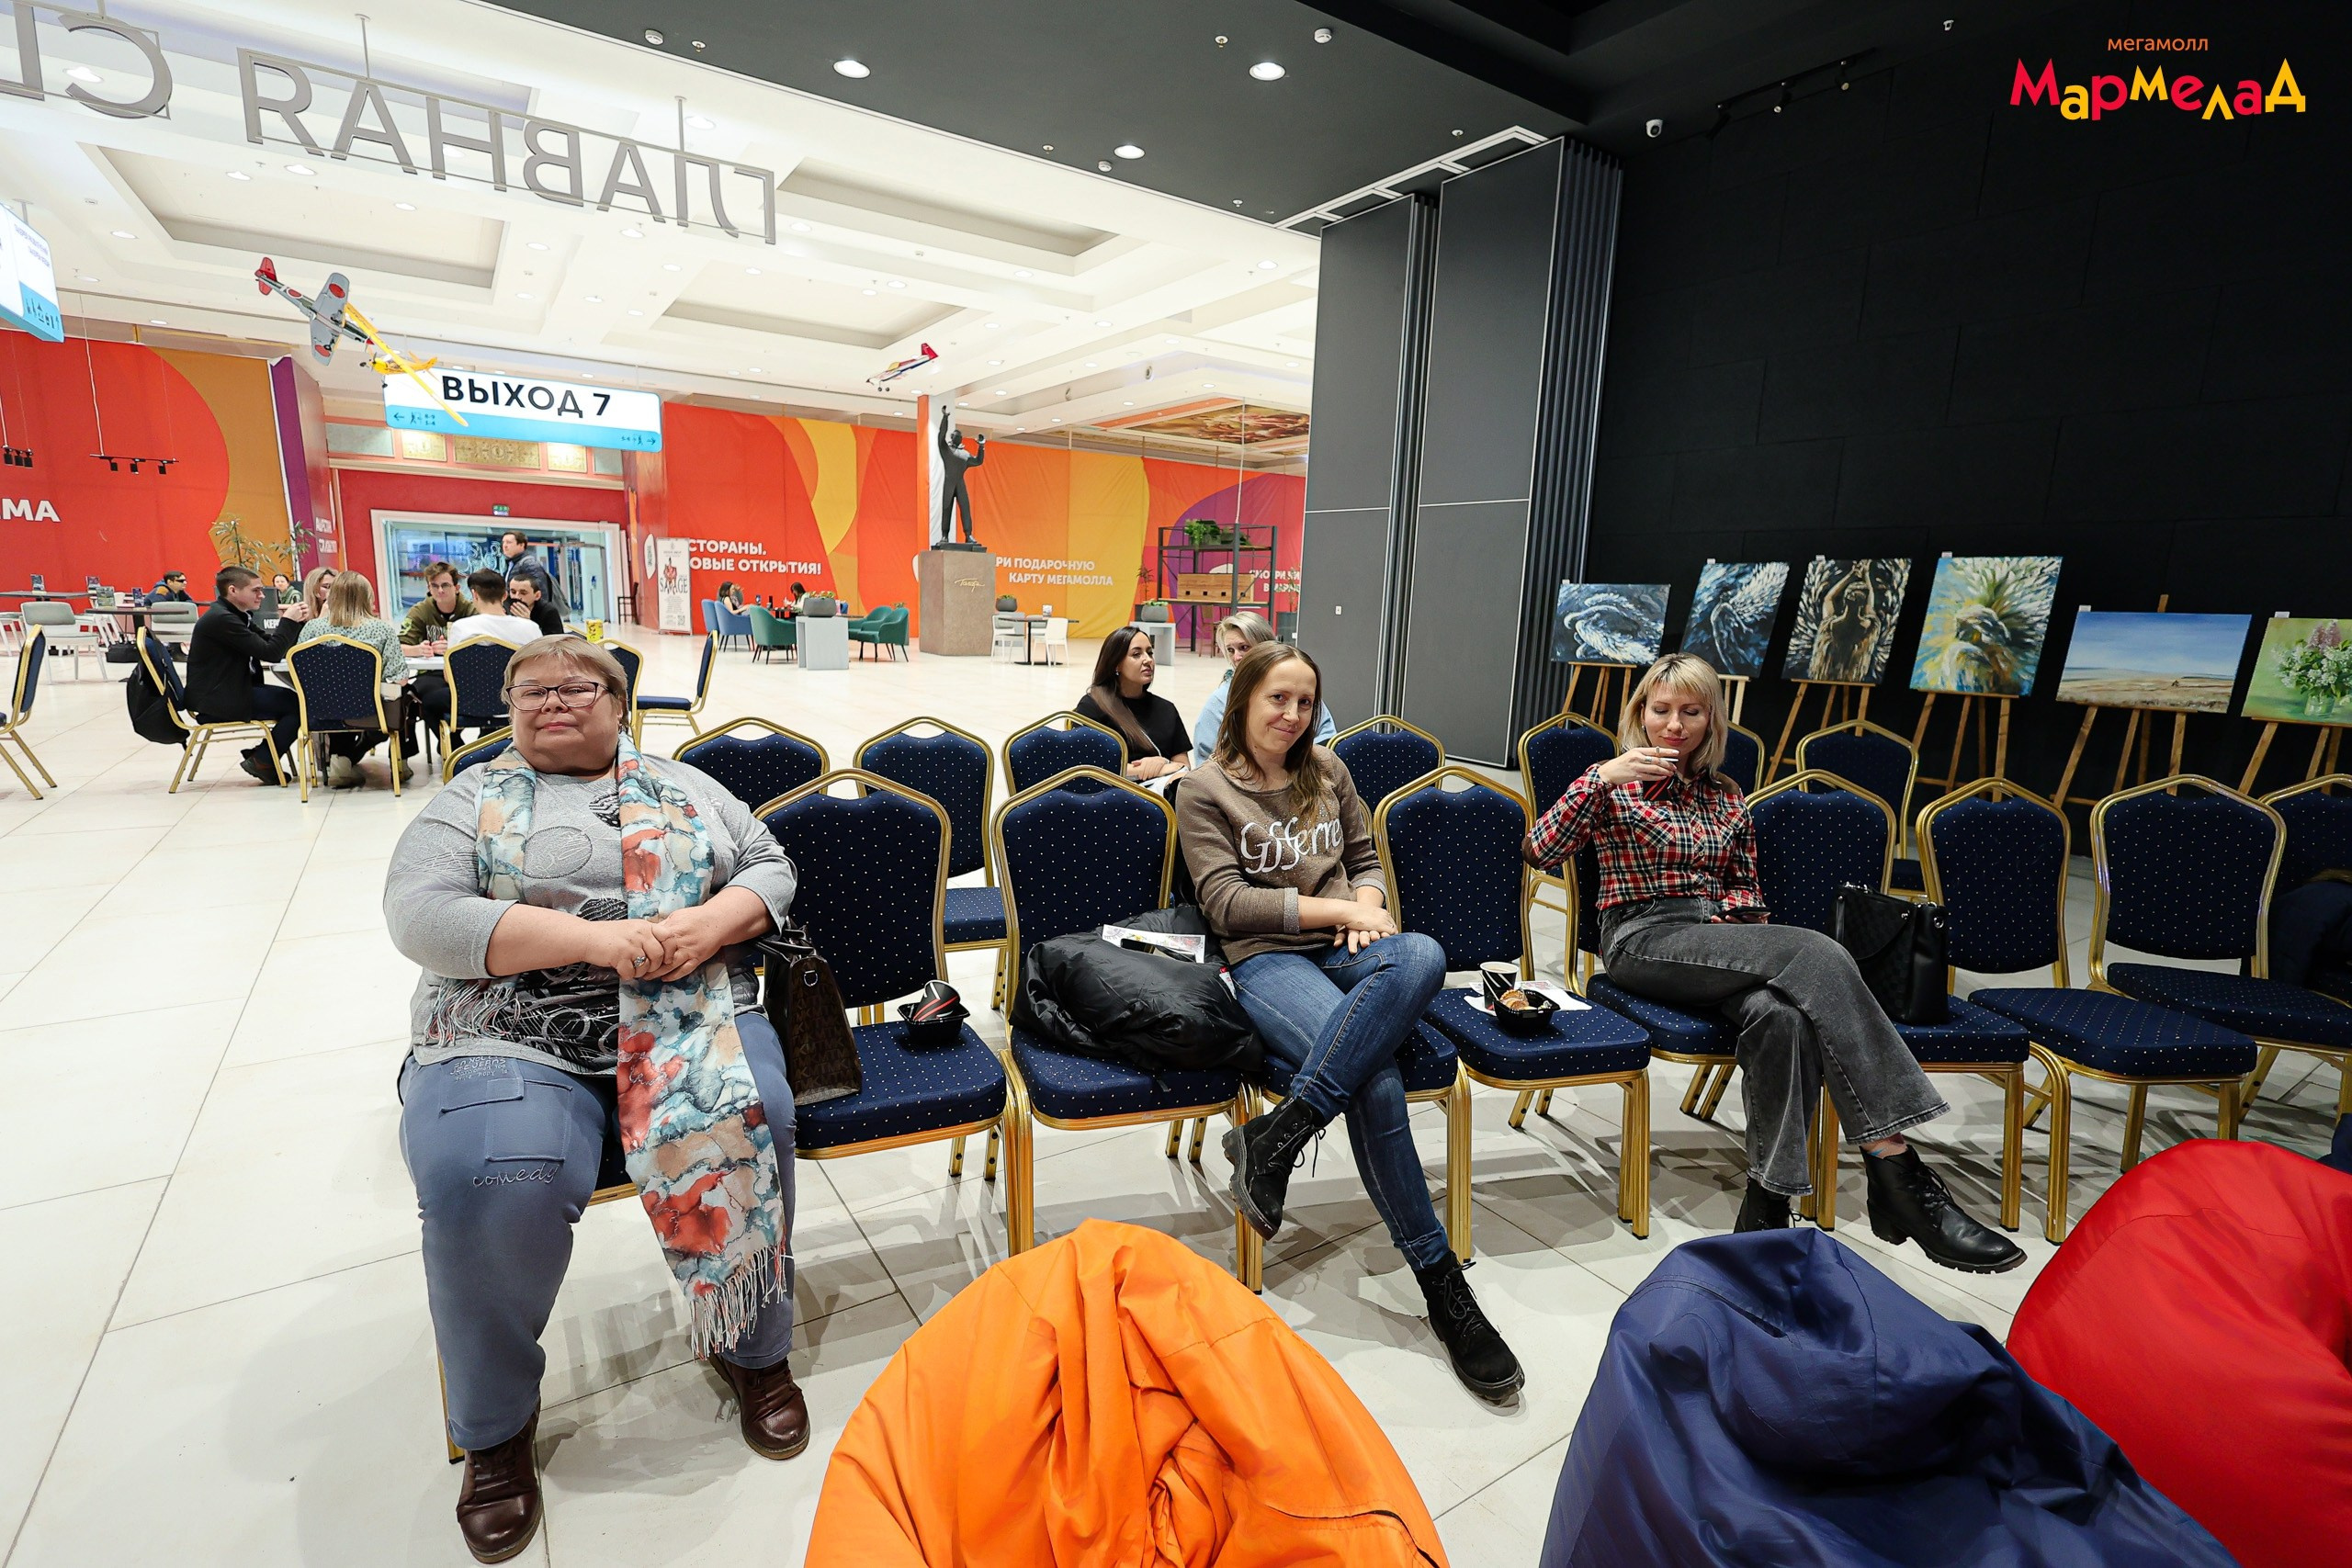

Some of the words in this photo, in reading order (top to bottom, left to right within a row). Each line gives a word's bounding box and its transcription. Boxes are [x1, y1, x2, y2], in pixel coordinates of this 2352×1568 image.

[442, 375, 583, 419] ВЫХОД
[593, 392, 611, 416] 7
[0, 498, 62, 522] МА
[689, 538, 767, 555] СТОРАНЫ.
[689, 557, 735, 571] ОВЫЕ
[738, 558, 821, 575] ОТКРЫТИЯ!
[995, 557, 1012, 568] РИ
[1014, 558, 1095, 571] ПОДАРОЧНУЮ
[1009, 572, 1045, 585] КАРТУ
[1047, 574, 1114, 586] МЕГАМОЛЛА
